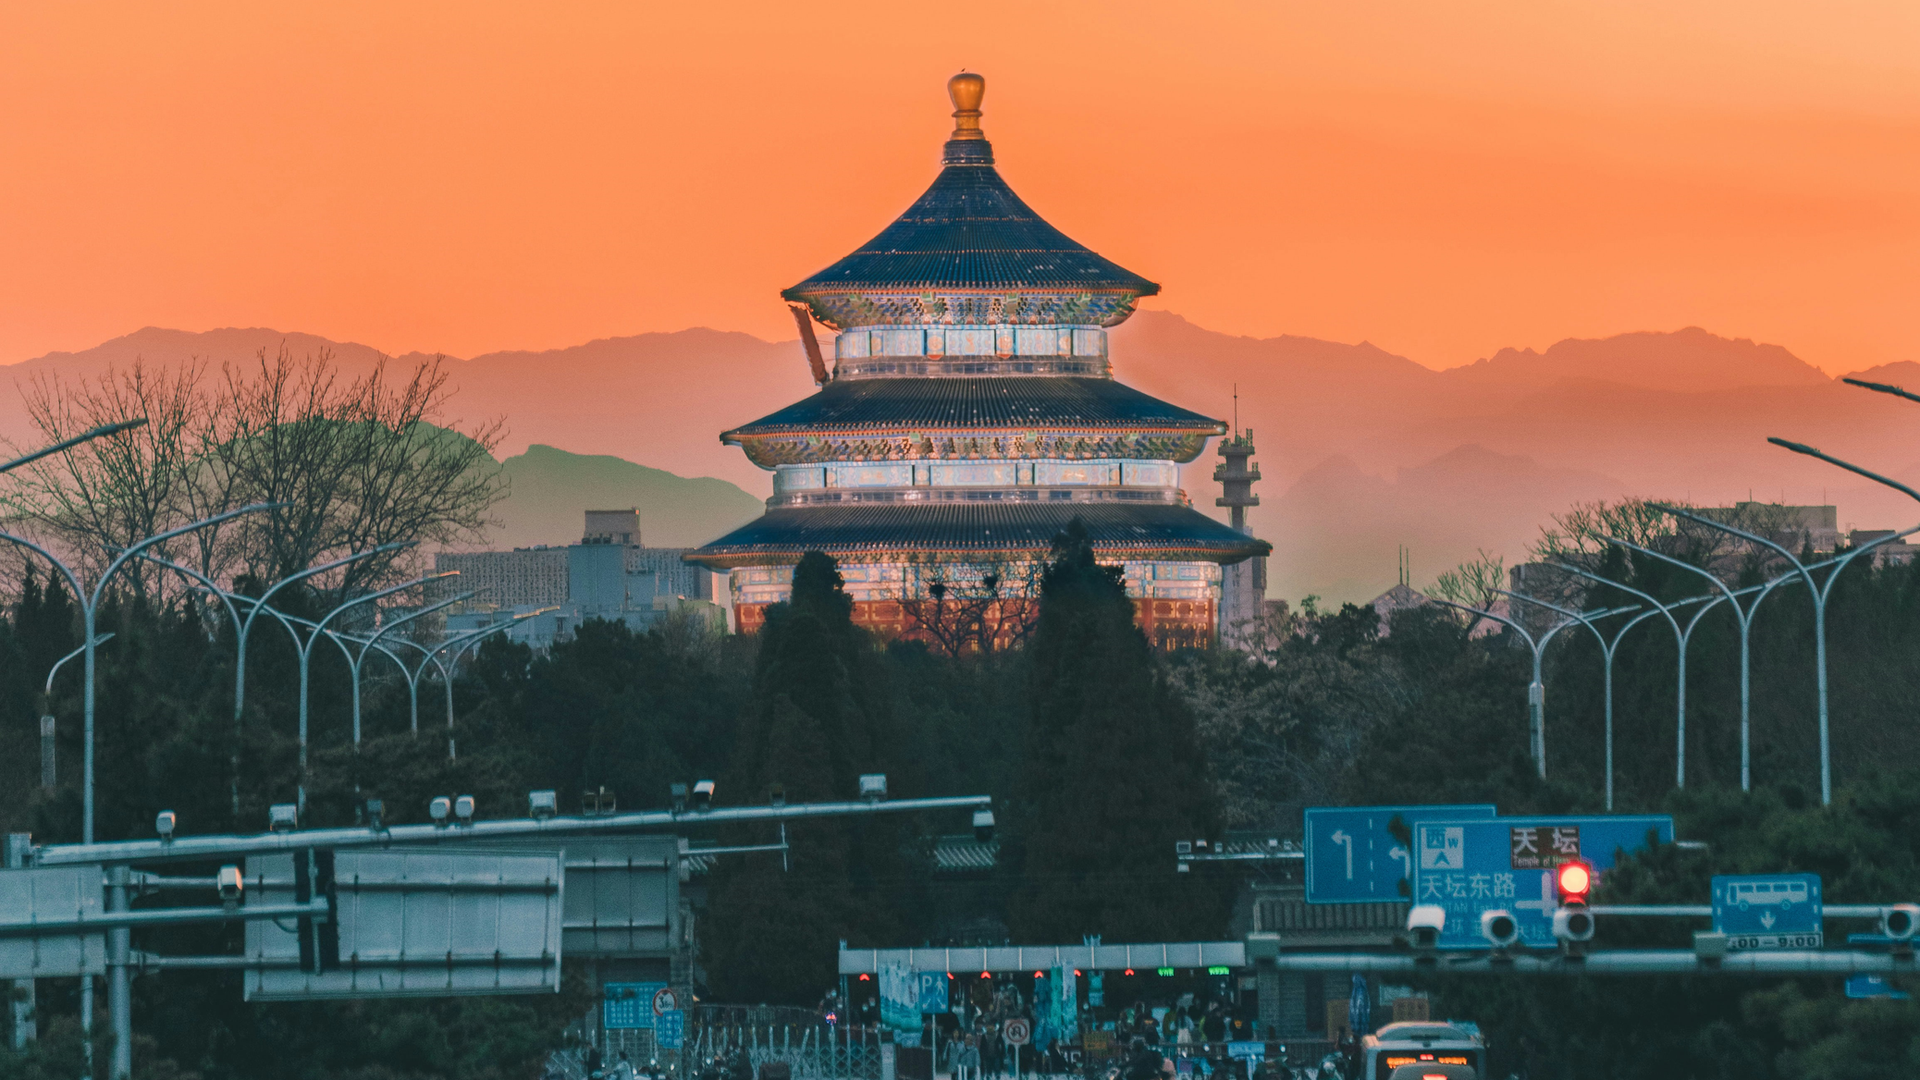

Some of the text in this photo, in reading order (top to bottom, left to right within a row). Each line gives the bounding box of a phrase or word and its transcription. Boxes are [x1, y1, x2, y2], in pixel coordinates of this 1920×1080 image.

[1426, 827, 1446, 849] 西
[1513, 828, 1578, 854] 天坛
[1513, 855, 1540, 867] Temple
[1421, 872, 1516, 899] 天坛东路
[922, 975, 933, 994] P
